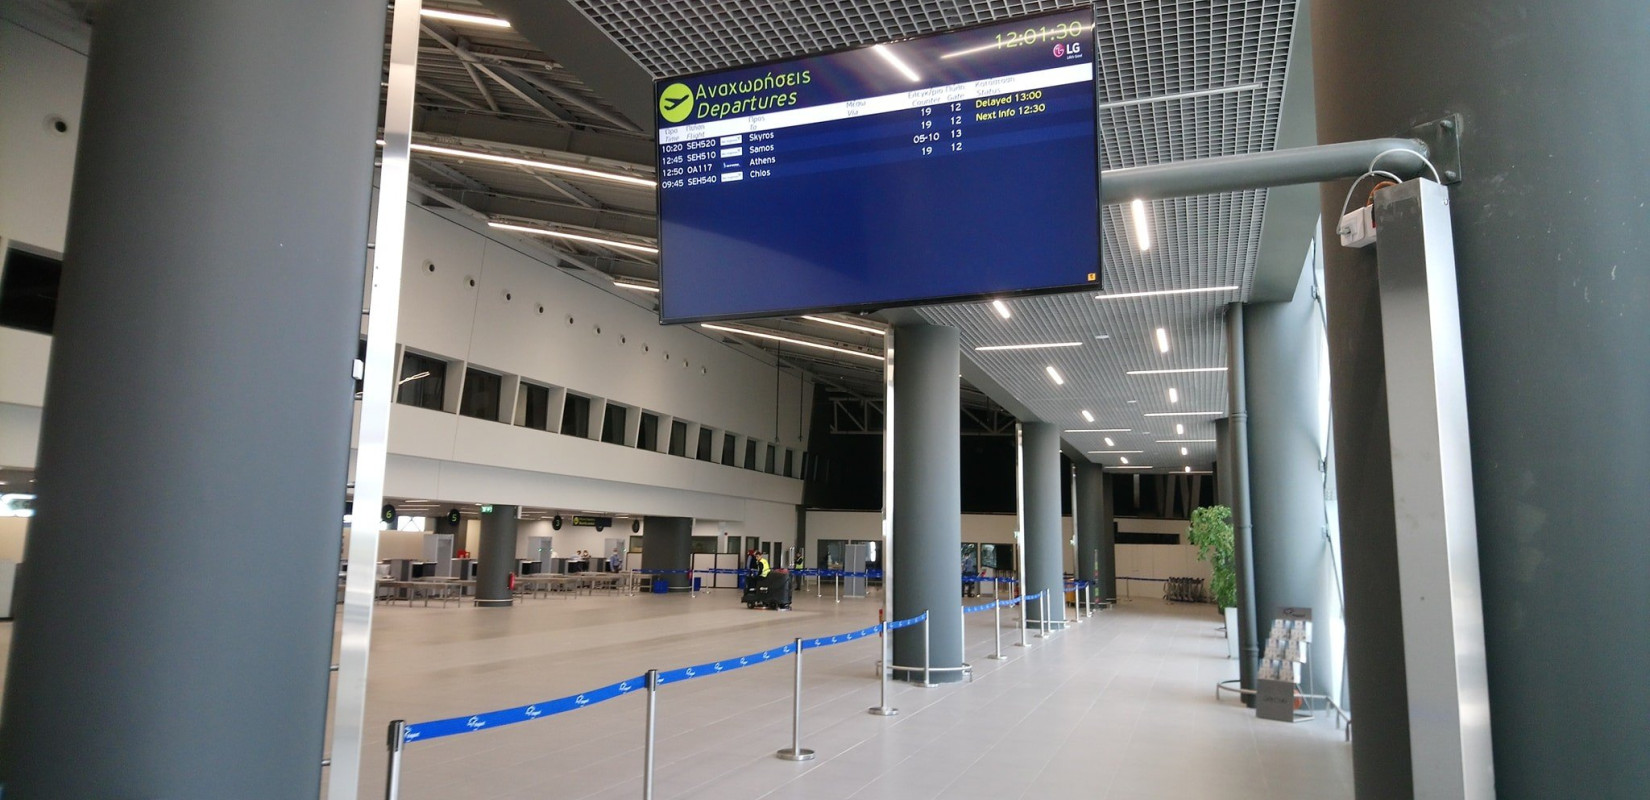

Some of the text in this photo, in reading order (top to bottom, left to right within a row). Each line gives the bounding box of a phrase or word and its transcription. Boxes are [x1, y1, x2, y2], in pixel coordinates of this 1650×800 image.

[995, 21, 1082, 49] 12:01:30
[1066, 42, 1081, 55] LG
[695, 70, 811, 100] Αναχωρήσεις
[686, 131, 705, 140] Flight
[912, 97, 941, 106] Counter
[947, 93, 965, 101] Gate
[976, 88, 1001, 97] Status
[697, 92, 798, 119] Departures
[662, 144, 683, 153] 10:20
[686, 139, 716, 150] SEH520
[749, 131, 774, 142] Skyros
[921, 107, 932, 117] 19
[950, 102, 961, 112] 12
[975, 94, 1012, 109] Delayed
[1015, 90, 1042, 102] 13:00
[662, 155, 683, 165] 12:45
[687, 151, 716, 162] SEH510
[749, 144, 774, 154] Samos
[921, 120, 932, 129] 19
[951, 116, 962, 125] 12
[975, 110, 997, 122] Next
[998, 107, 1015, 119] Info
[1019, 103, 1046, 115] 12:30
[662, 167, 684, 177] 12:50
[749, 156, 776, 166] Athens
[913, 132, 940, 144] 05-10
[951, 129, 962, 138] 13
[662, 179, 684, 189] 09:45
[687, 175, 717, 186] SEH540
[750, 169, 771, 178] Chios
[922, 146, 933, 156] 19
[951, 142, 962, 152] 12
[386, 510, 392, 519] 6
[452, 513, 457, 522] 5
